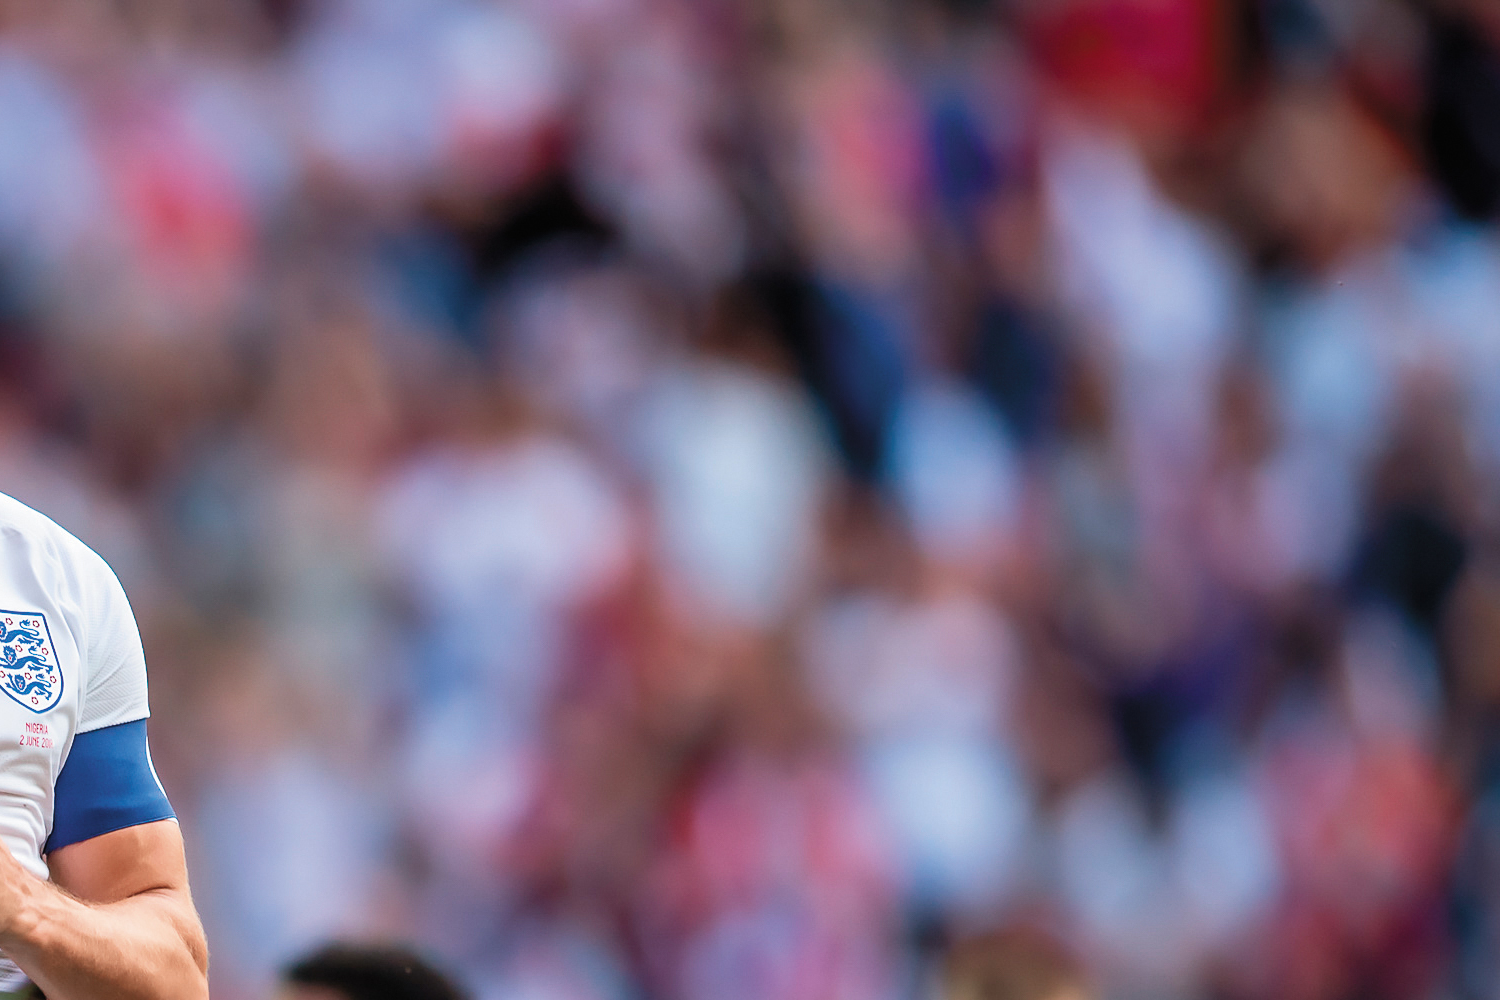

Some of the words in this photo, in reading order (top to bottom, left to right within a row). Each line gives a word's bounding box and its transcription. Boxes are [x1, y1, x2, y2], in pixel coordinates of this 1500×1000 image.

[25, 722, 49, 735] NIGERIA
[19, 734, 25, 746] 2
[25, 736, 40, 748] JUNE
